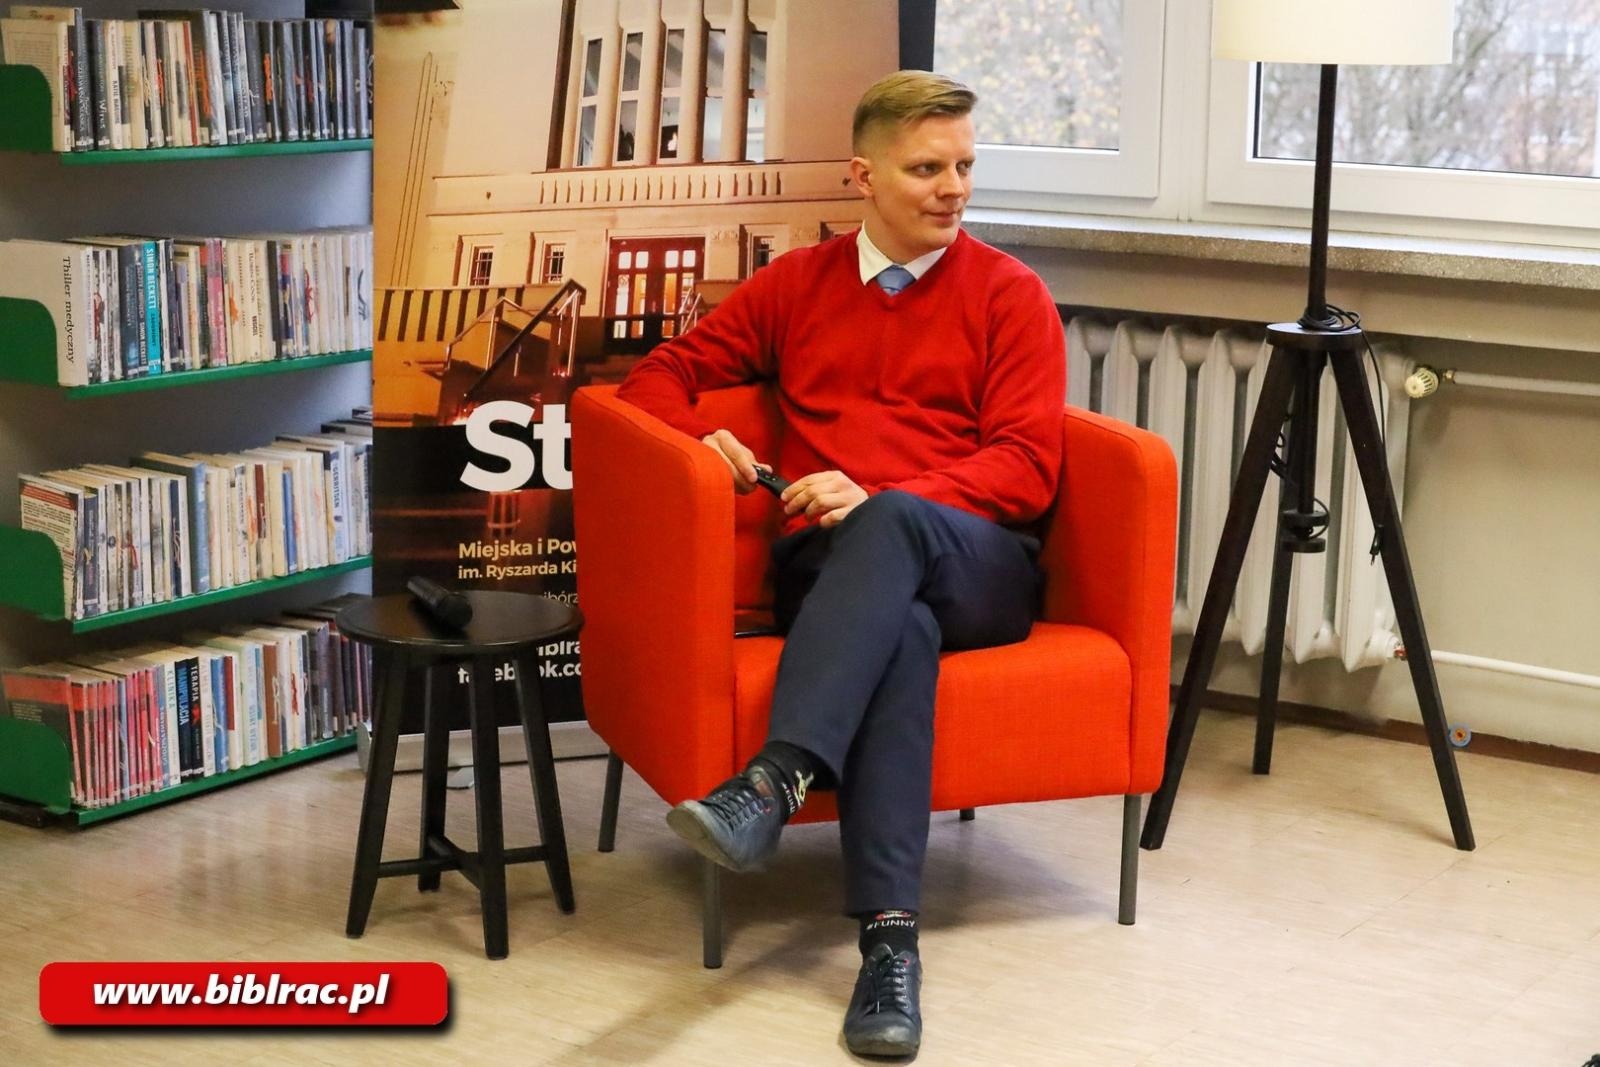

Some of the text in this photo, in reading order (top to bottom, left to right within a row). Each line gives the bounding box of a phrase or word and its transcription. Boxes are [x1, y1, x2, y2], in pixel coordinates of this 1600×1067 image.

[99, 99, 107, 129] Wirus
[146, 248, 156, 274] SIMON
[62, 256, 75, 364] Thiller medyczny
[147, 275, 157, 310] BECKETT
[459, 400, 574, 492] St
[458, 539, 533, 561] Miejska
[537, 538, 543, 555] i
[458, 565, 483, 579] im.
[486, 561, 558, 580] Ryszarda
[166, 670, 175, 710] KLINIKA
[177, 668, 190, 725] MANIPULACJA
[190, 665, 199, 702] TERAPIA
